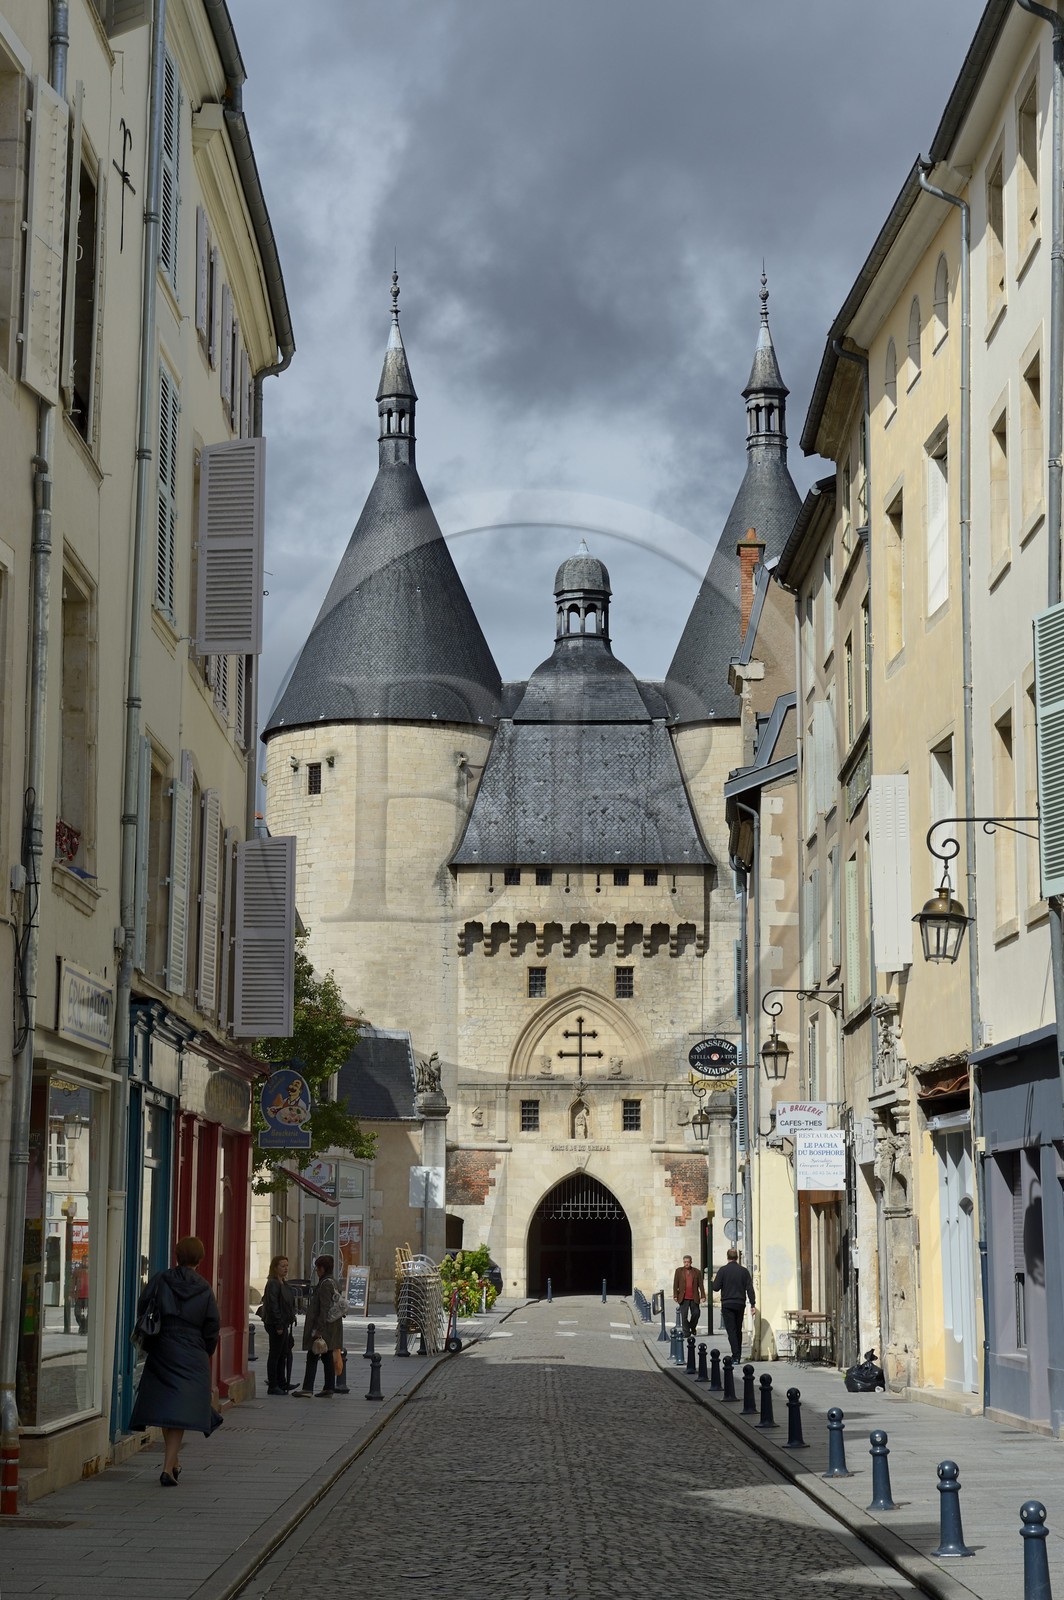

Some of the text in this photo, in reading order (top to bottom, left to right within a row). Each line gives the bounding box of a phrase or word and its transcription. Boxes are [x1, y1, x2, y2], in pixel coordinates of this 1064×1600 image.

[695, 1040, 735, 1053] BRASSERIE
[778, 1104, 823, 1116] LA BRULERIE
